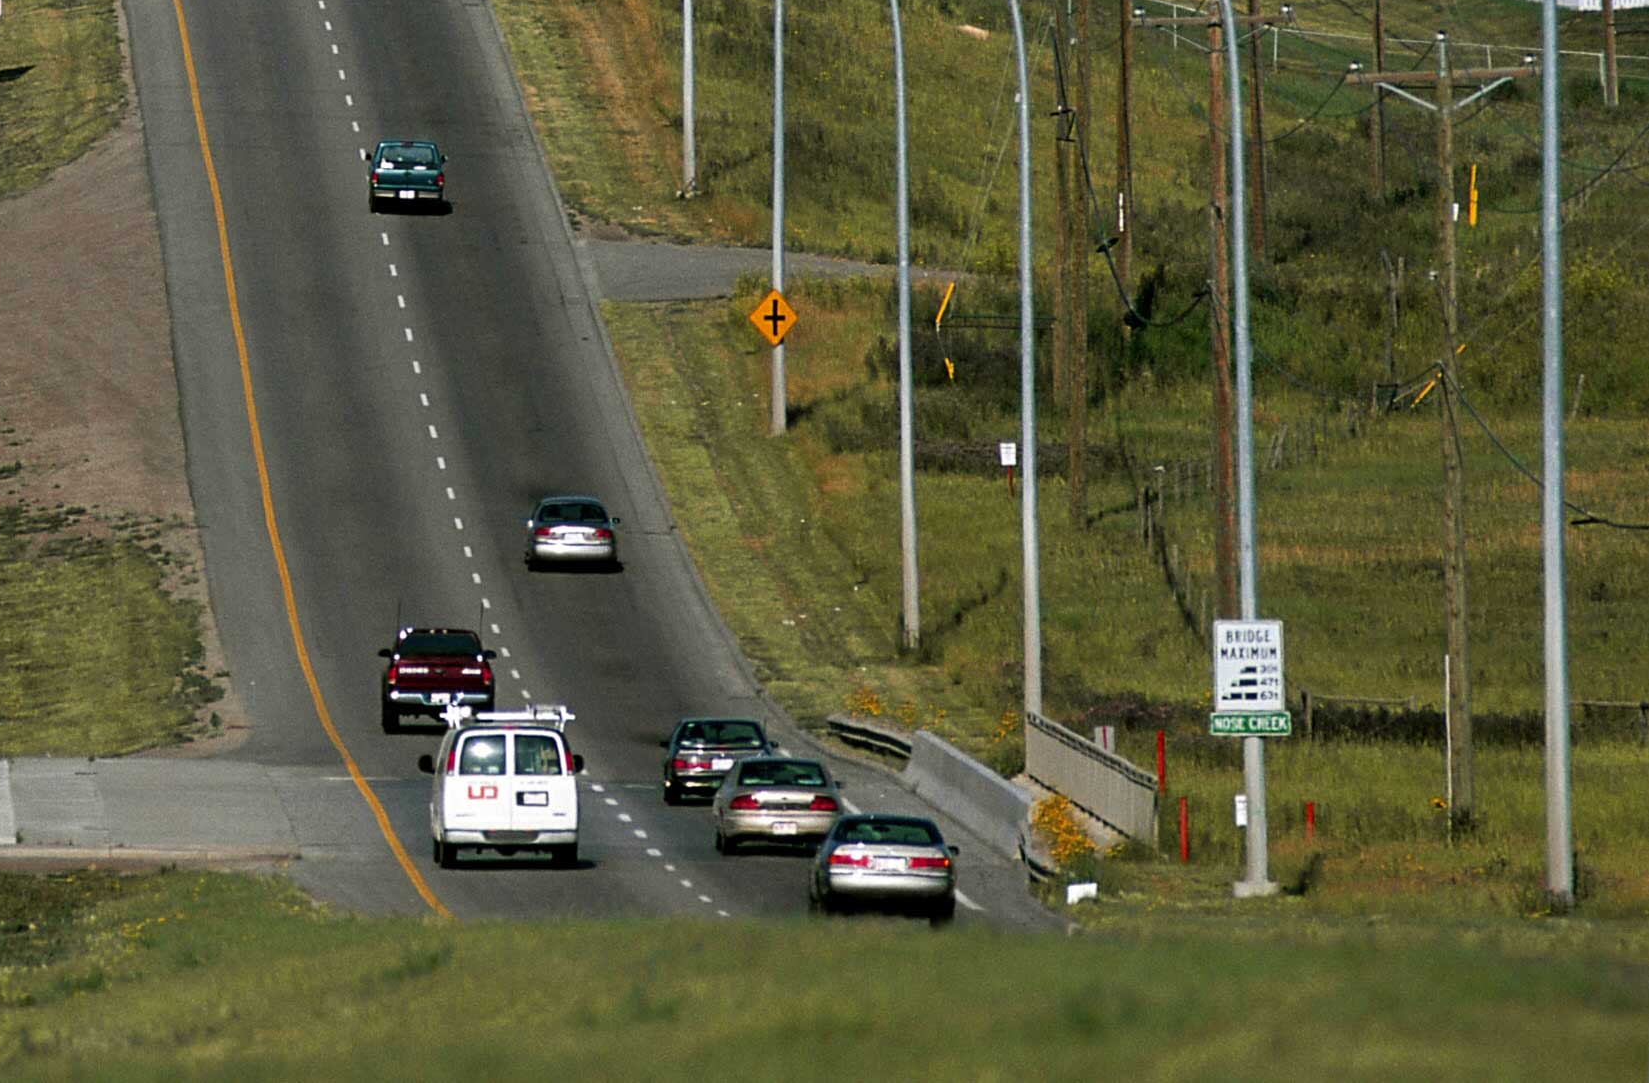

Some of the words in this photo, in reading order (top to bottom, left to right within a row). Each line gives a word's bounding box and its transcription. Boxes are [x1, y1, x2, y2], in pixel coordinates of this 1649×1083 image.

[1226, 629, 1271, 644] BRIDGE
[1221, 647, 1277, 660] MAXIMUM
[1214, 717, 1244, 730] NOSE
[1248, 717, 1287, 730] CREEK
